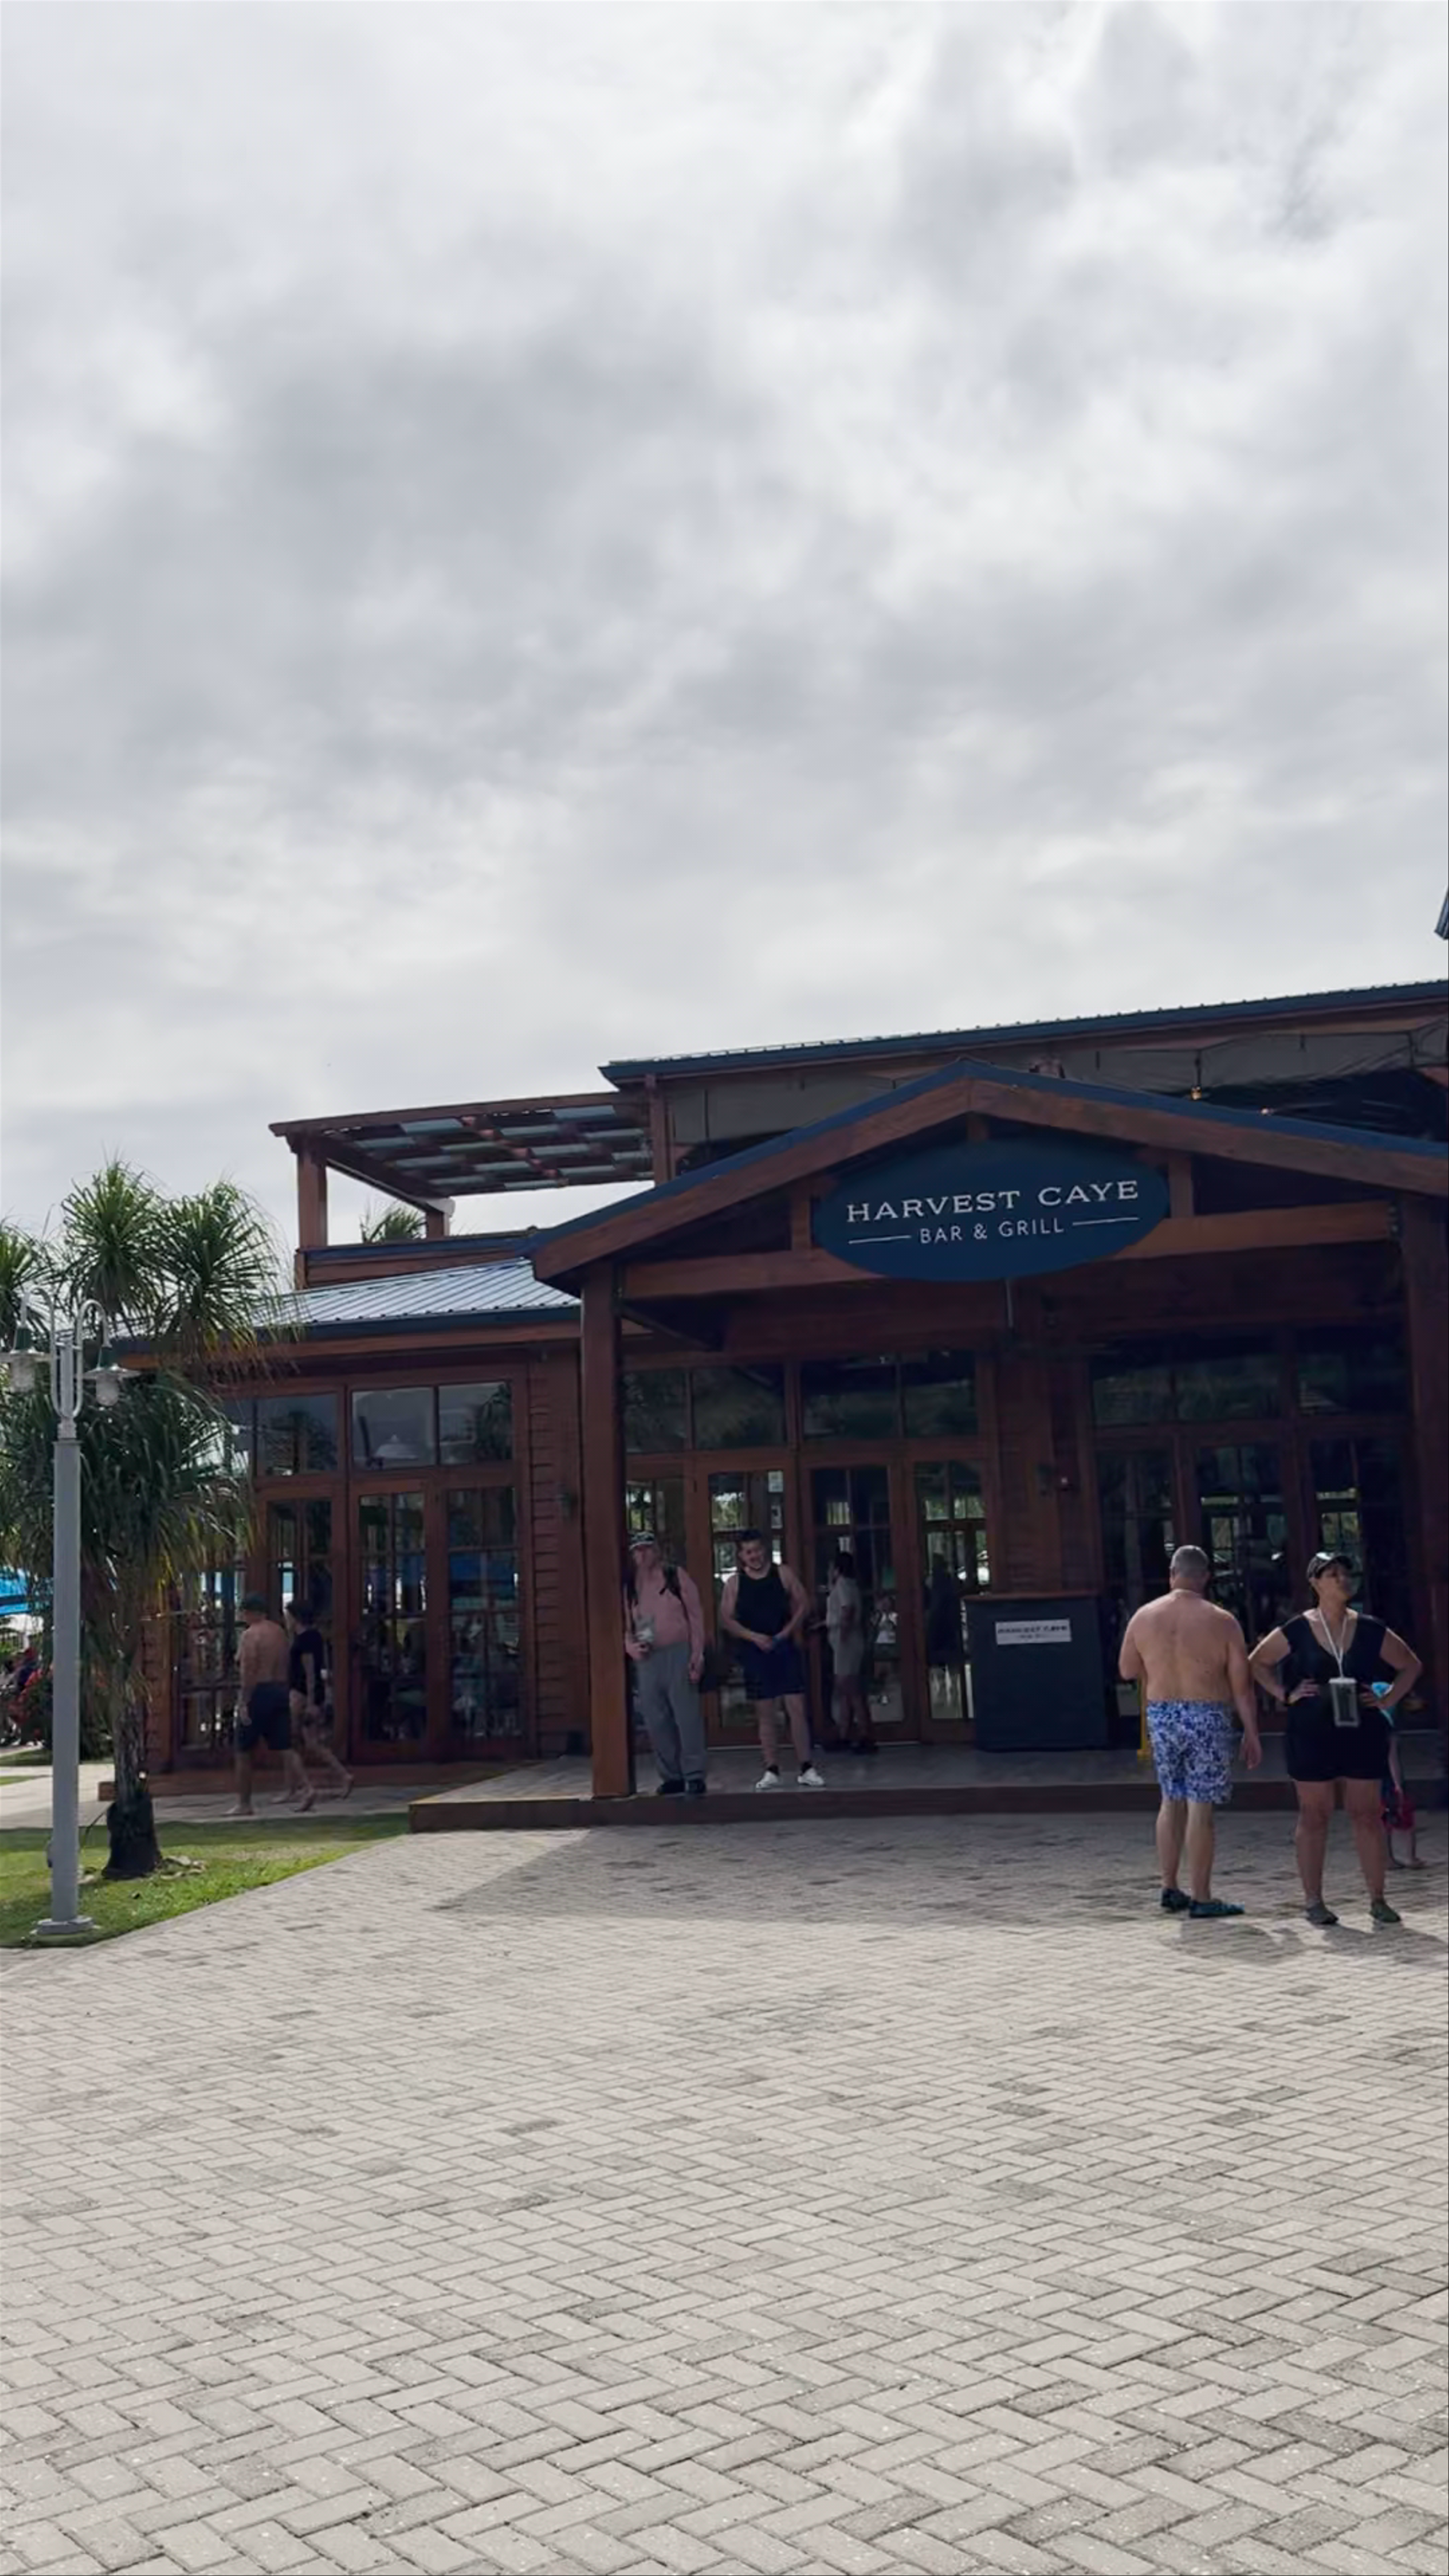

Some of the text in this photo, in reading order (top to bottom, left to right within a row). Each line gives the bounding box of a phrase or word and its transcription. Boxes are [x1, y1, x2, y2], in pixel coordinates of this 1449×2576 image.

[847, 1180, 1138, 1223] HARVEST CAYE
[920, 1218, 1063, 1244] BAR & GRILL
